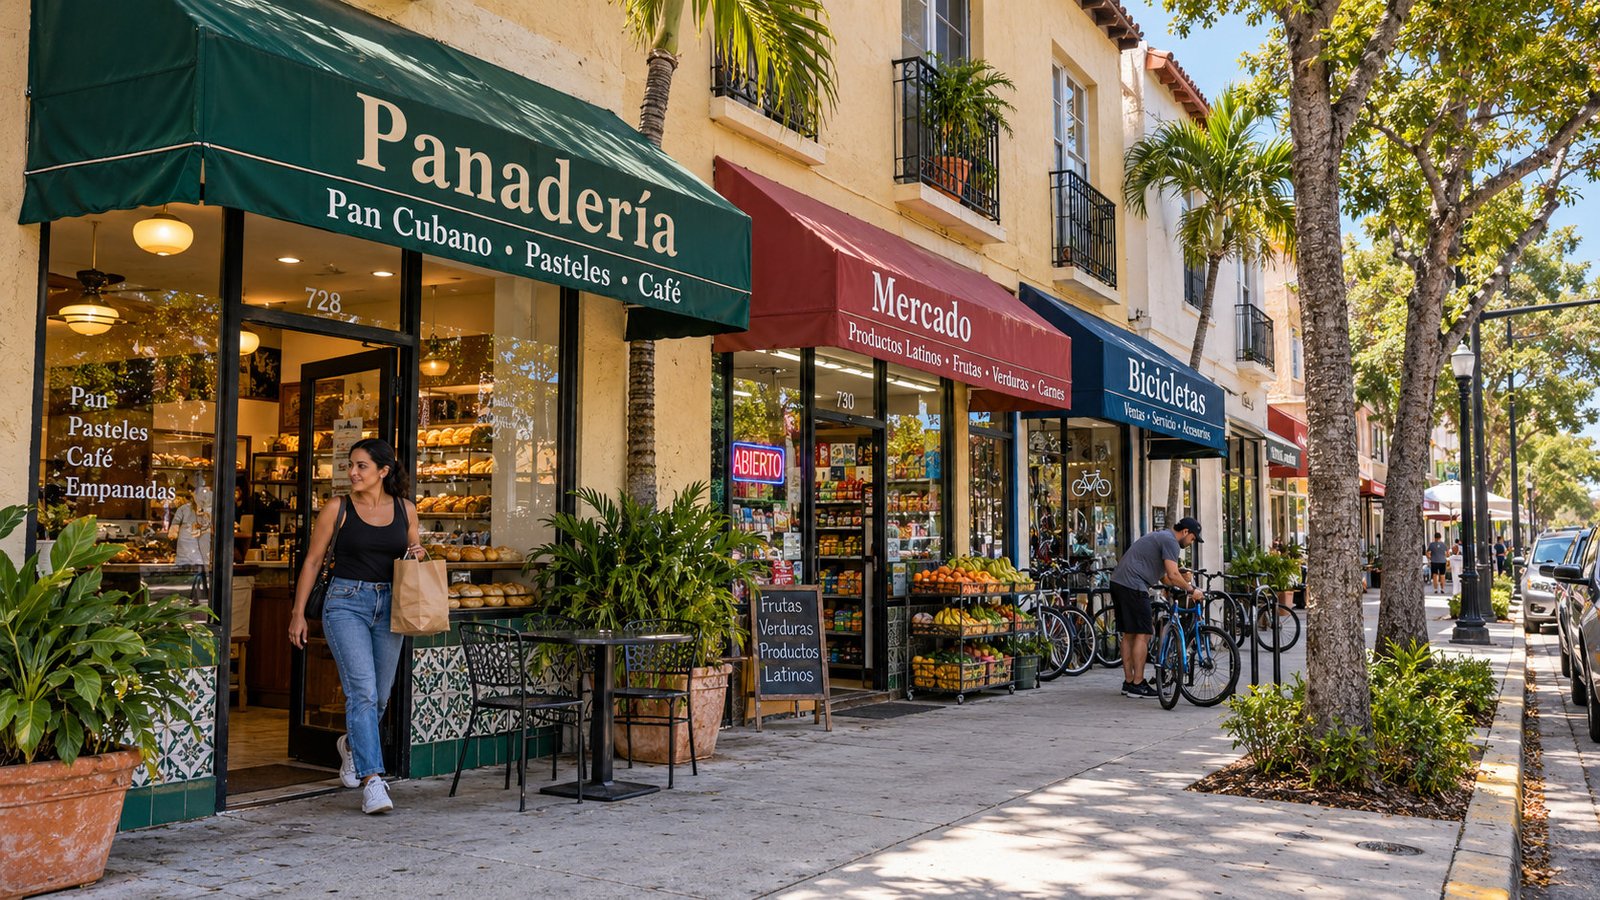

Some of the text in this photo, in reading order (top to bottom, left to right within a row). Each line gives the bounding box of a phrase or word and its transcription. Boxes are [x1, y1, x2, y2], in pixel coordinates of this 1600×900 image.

[356, 91, 678, 257] Panadería
[327, 188, 682, 304] Pan Cubano Pasteles Café
[306, 287, 341, 314] 728
[872, 271, 971, 343] Mercado
[849, 322, 1065, 401] Productos Latinos Frutas Verduras Carnes
[70, 385, 109, 409] Pan
[1128, 357, 1206, 415] Bicicletas
[837, 391, 855, 410] 730
[1124, 401, 1145, 421] Ventas
[1152, 410, 1176, 430] Servicio
[68, 416, 148, 442] Pasteles
[67, 446, 113, 468] Café
[733, 449, 782, 478] ABIERTO
[65, 477, 176, 503] Empanadas
[761, 596, 803, 613] Frutas
[759, 619, 814, 636] Verduras
[759, 642, 819, 659] Productos
[765, 666, 814, 683] Latinos
